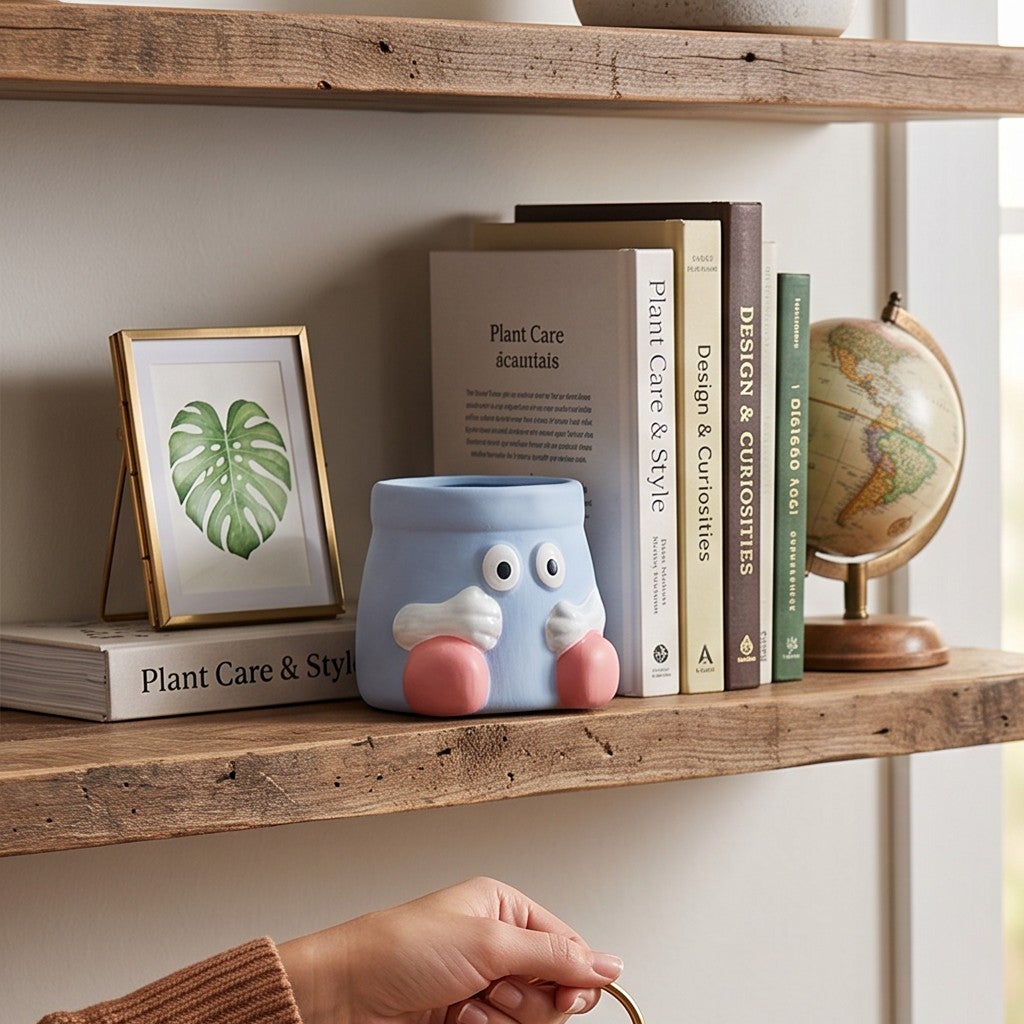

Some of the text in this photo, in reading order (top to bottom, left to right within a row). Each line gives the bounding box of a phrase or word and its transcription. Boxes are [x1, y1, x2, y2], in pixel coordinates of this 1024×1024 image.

[490, 323, 565, 344] Plant Care
[647, 280, 670, 513] Plant Care & Style
[739, 306, 754, 576] DESIGN & CURIOSITIES
[694, 345, 713, 562] Design & Curiosities
[141, 650, 356, 693] Plant Care & Styl
